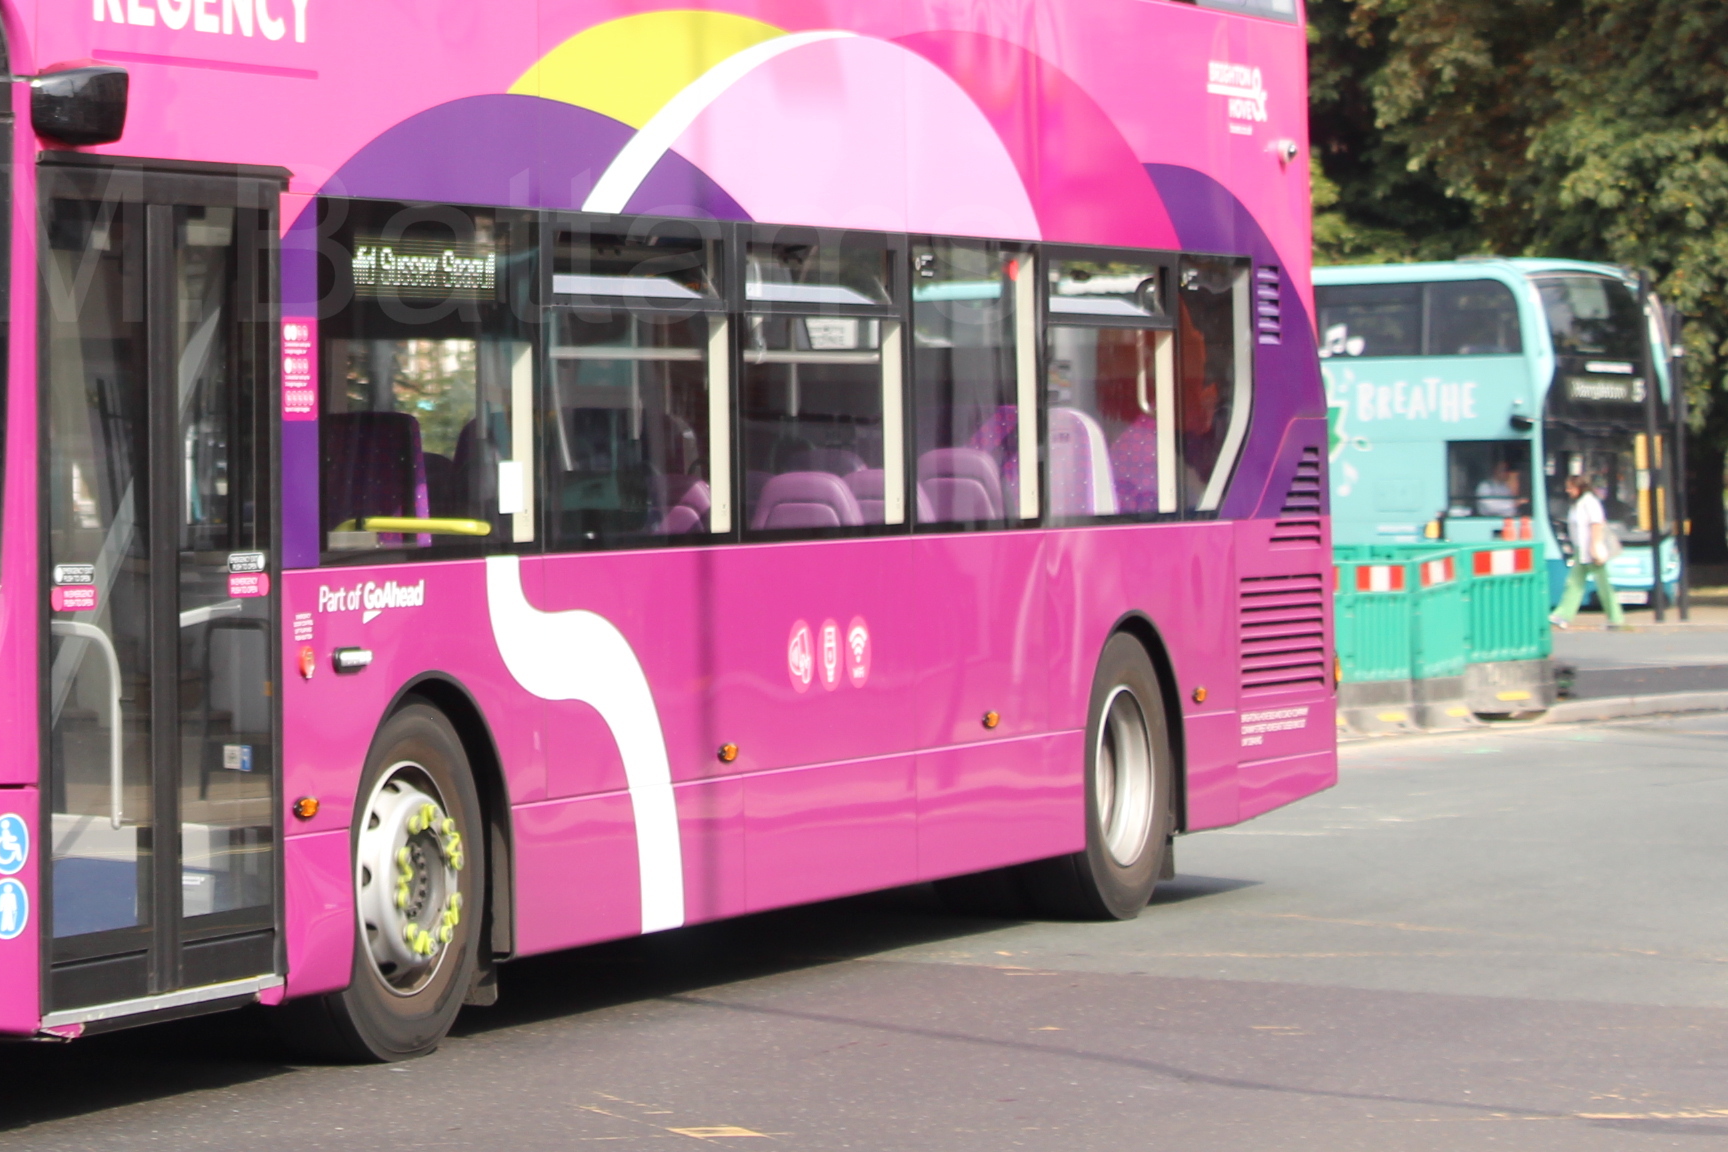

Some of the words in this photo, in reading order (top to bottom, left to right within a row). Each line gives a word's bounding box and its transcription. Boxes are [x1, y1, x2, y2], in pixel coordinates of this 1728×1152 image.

[1356, 377, 1478, 423] BREATHE
[318, 584, 346, 613] Part
[347, 583, 363, 610] of
